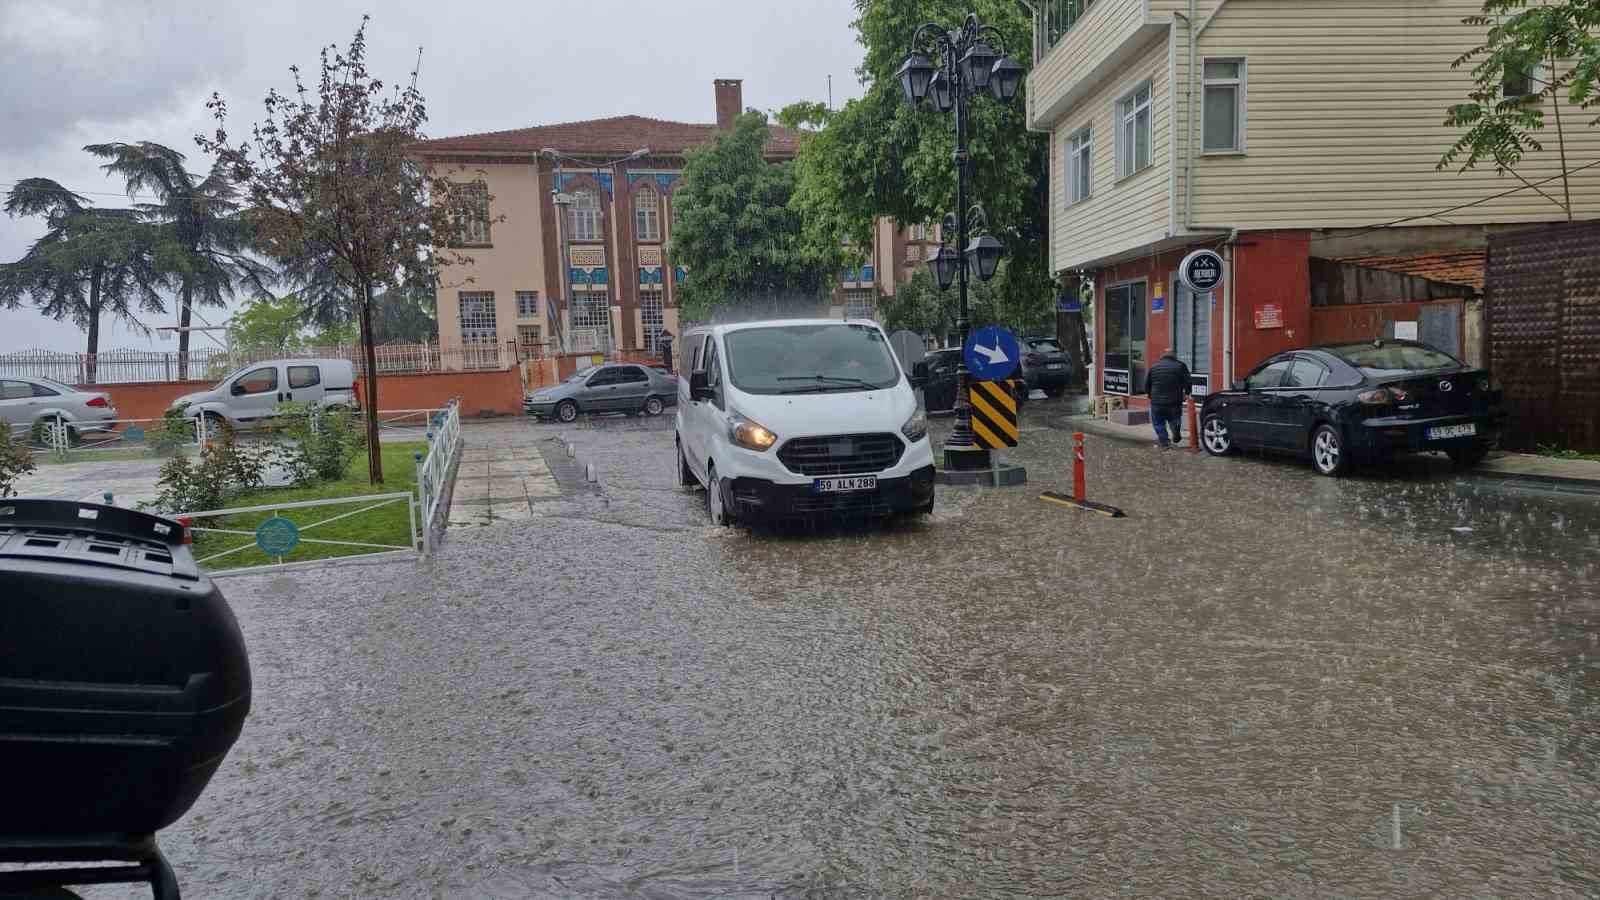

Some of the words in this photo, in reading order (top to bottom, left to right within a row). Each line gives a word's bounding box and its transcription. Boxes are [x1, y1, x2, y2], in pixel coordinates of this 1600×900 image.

[820, 480, 831, 490] 59
[837, 479, 855, 489] ALN
[857, 478, 875, 488] 288
